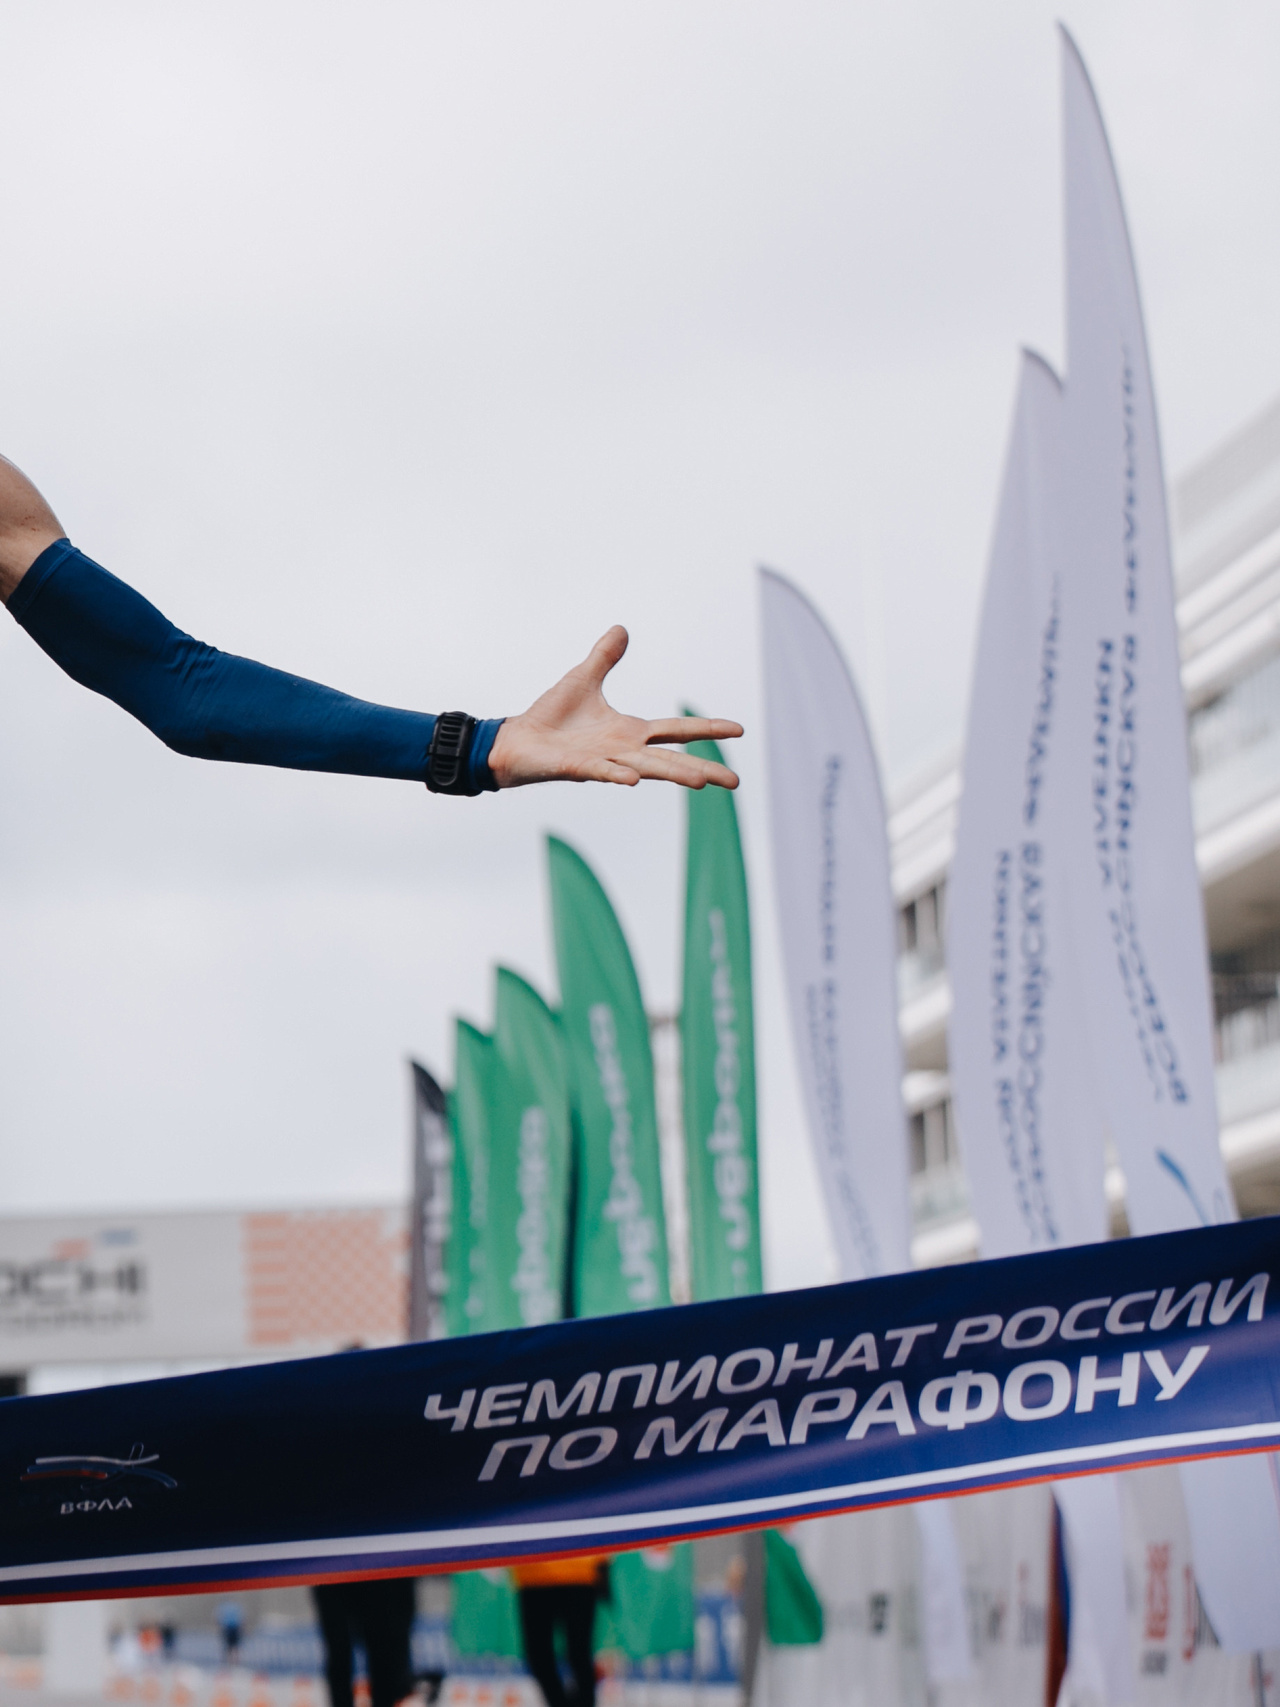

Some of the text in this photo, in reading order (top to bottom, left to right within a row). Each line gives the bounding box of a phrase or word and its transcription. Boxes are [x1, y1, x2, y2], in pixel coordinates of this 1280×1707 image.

[423, 1272, 1270, 1432] ЧЕМПИОНАТ РОССИИ
[478, 1345, 1210, 1482] ПО МАРАФОНУ
[60, 1496, 133, 1515] ВФЛА
